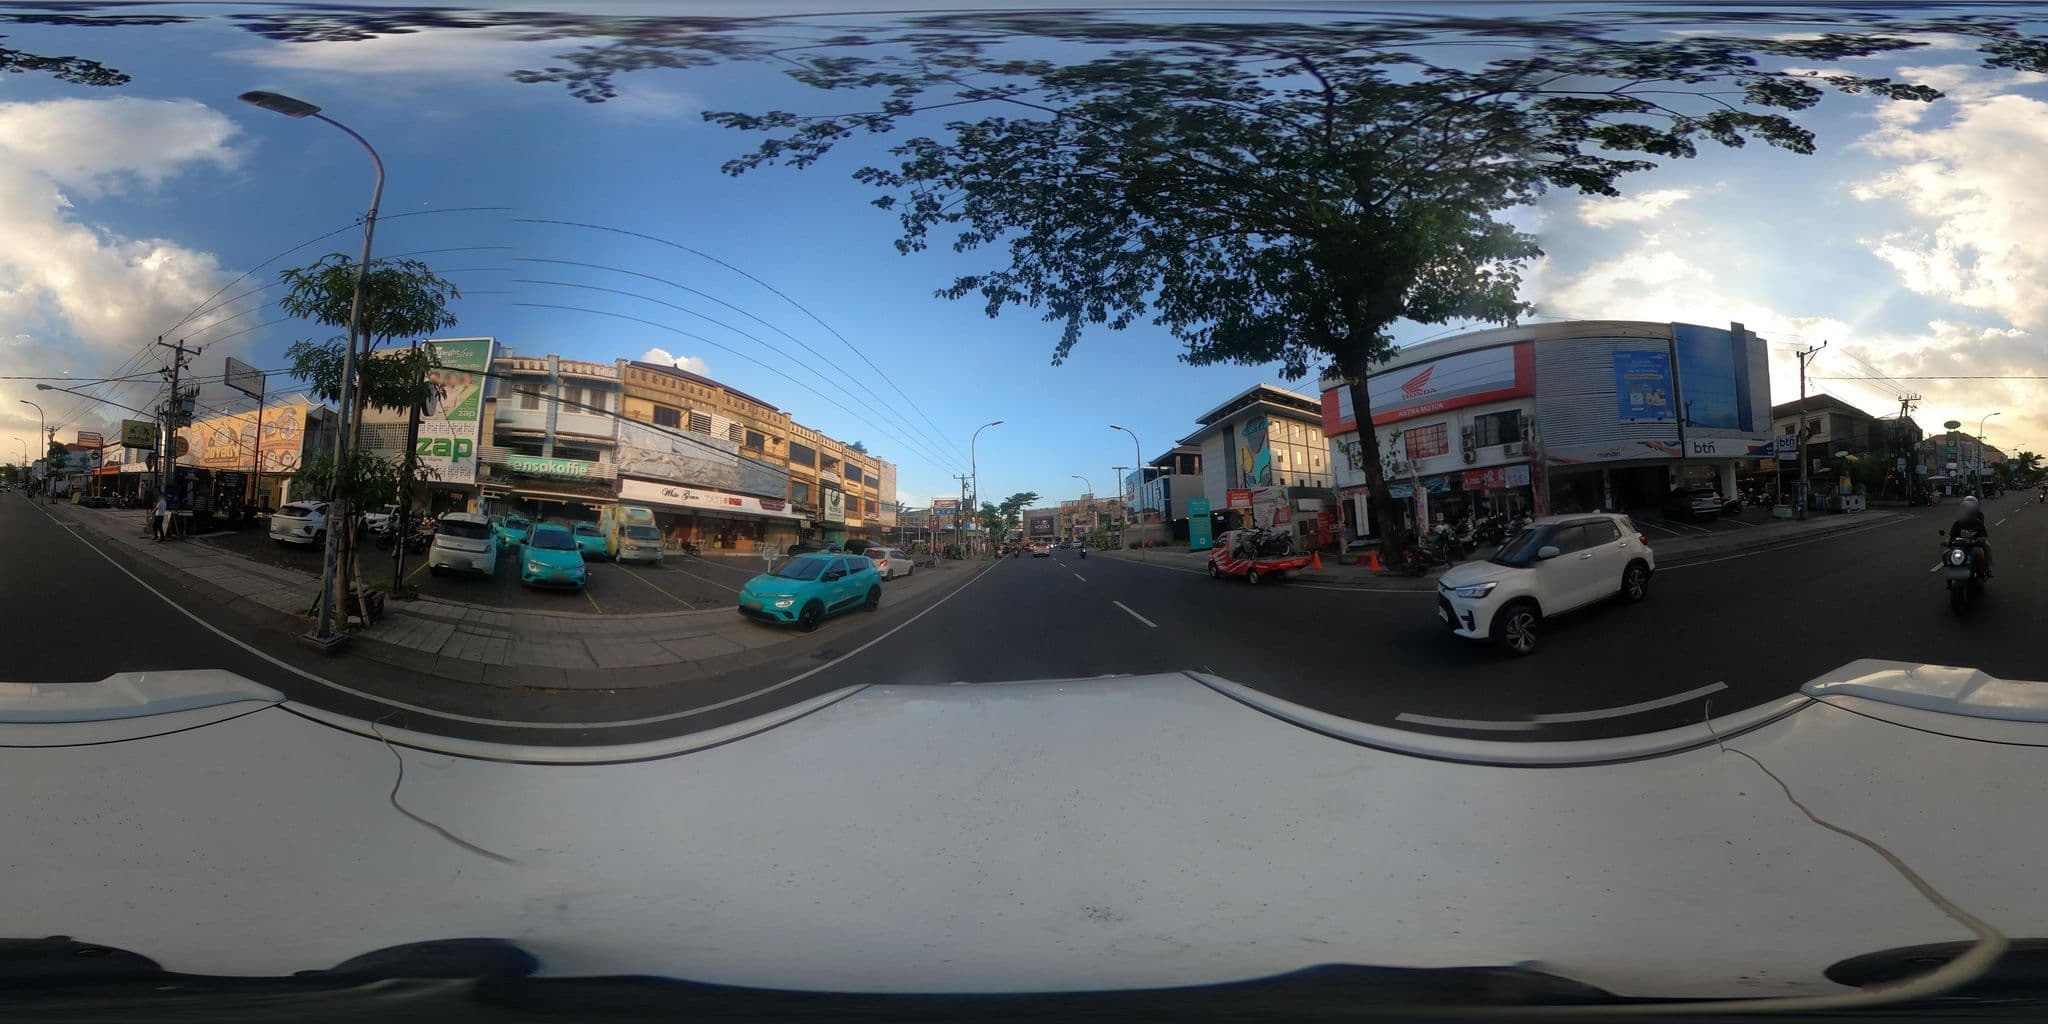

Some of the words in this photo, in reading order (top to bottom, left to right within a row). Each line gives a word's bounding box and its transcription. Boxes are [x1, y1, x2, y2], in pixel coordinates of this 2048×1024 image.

[1402, 388, 1440, 400] HONDA
[1398, 407, 1420, 417] ASTRA
[1420, 402, 1444, 414] MOTOR
[1693, 440, 1715, 454] btn
[1779, 436, 1795, 449] btn
[416, 437, 473, 463] zap
